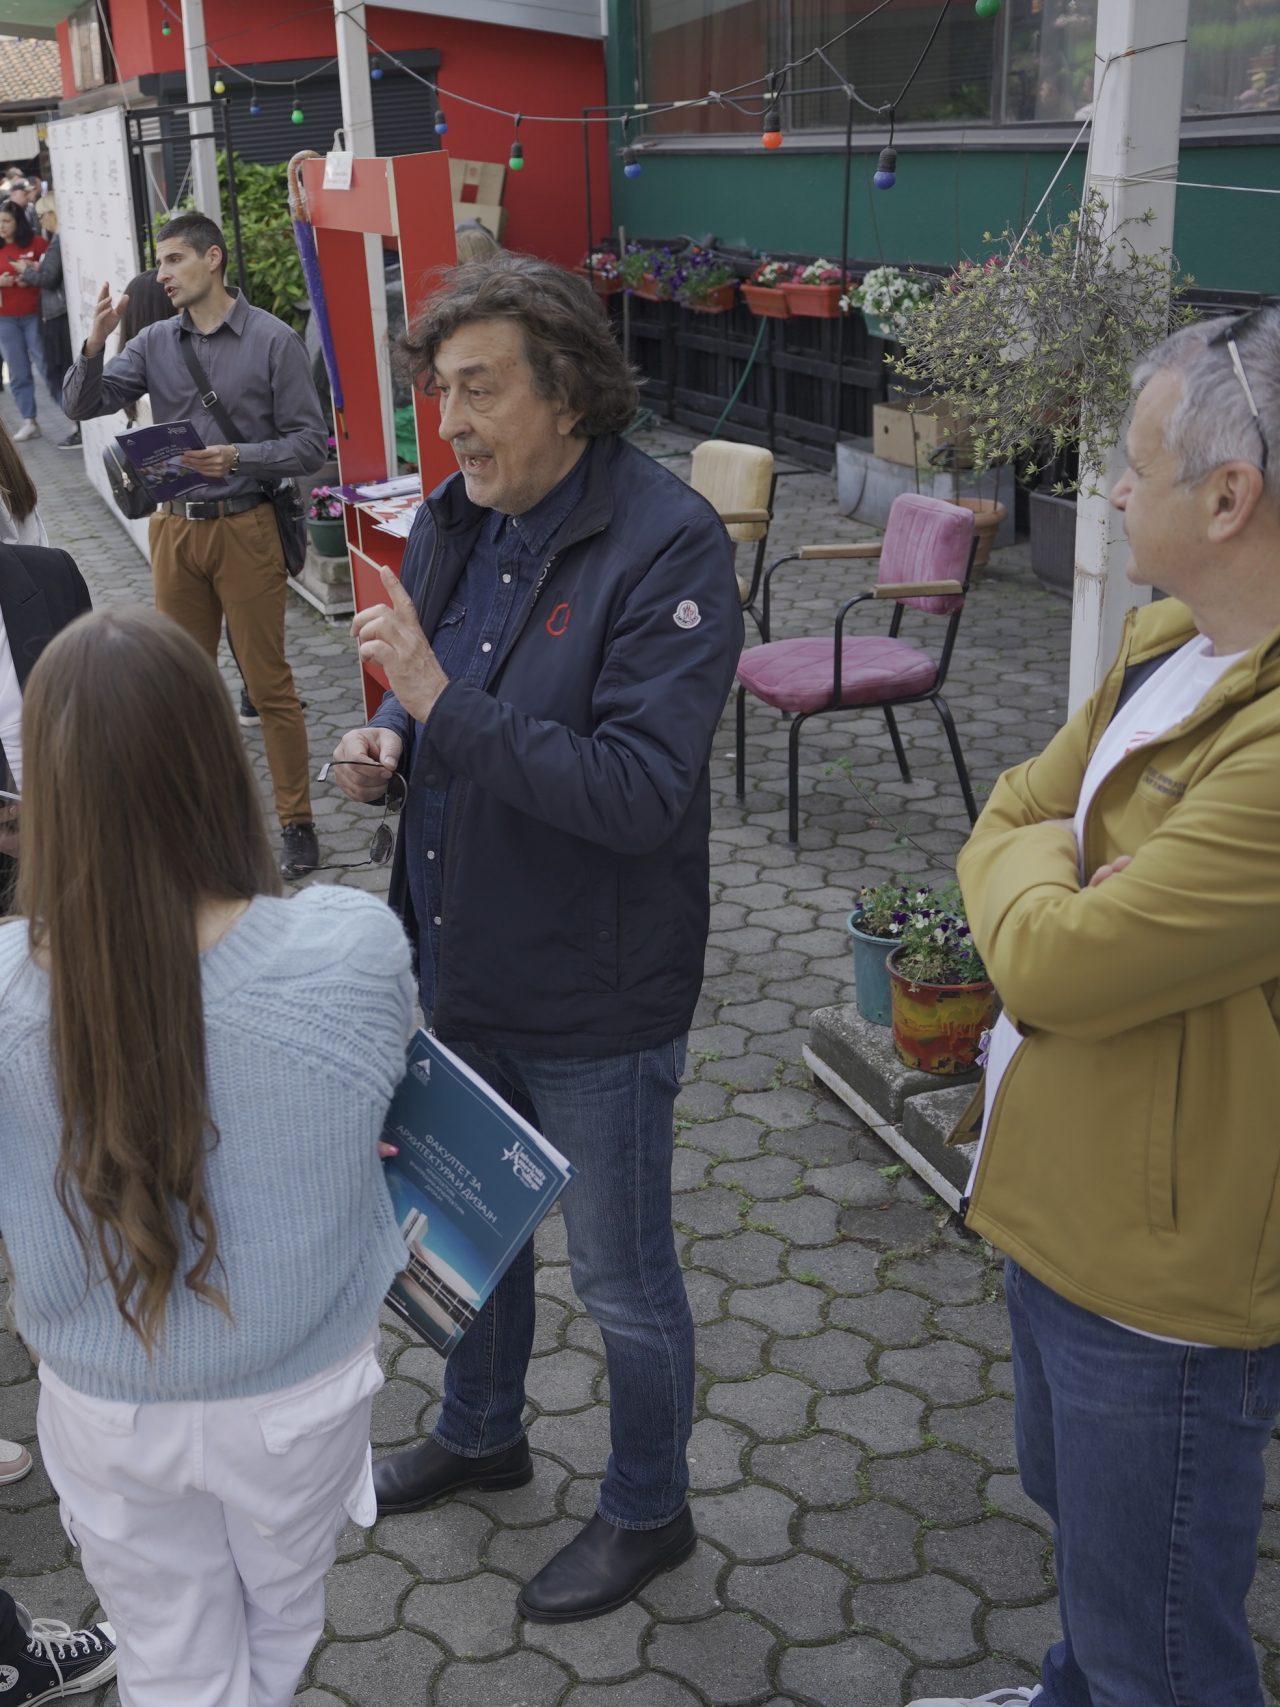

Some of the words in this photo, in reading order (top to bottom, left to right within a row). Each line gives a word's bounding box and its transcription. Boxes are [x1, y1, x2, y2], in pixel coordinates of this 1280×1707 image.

[396, 1124, 455, 1182] АРХИТЕКТУРА
[454, 1180, 464, 1190] И
[461, 1188, 498, 1224] ДИЗАЈН
[425, 1134, 471, 1178] ФАКУЛТЕТ
[469, 1179, 482, 1192] ЗА
